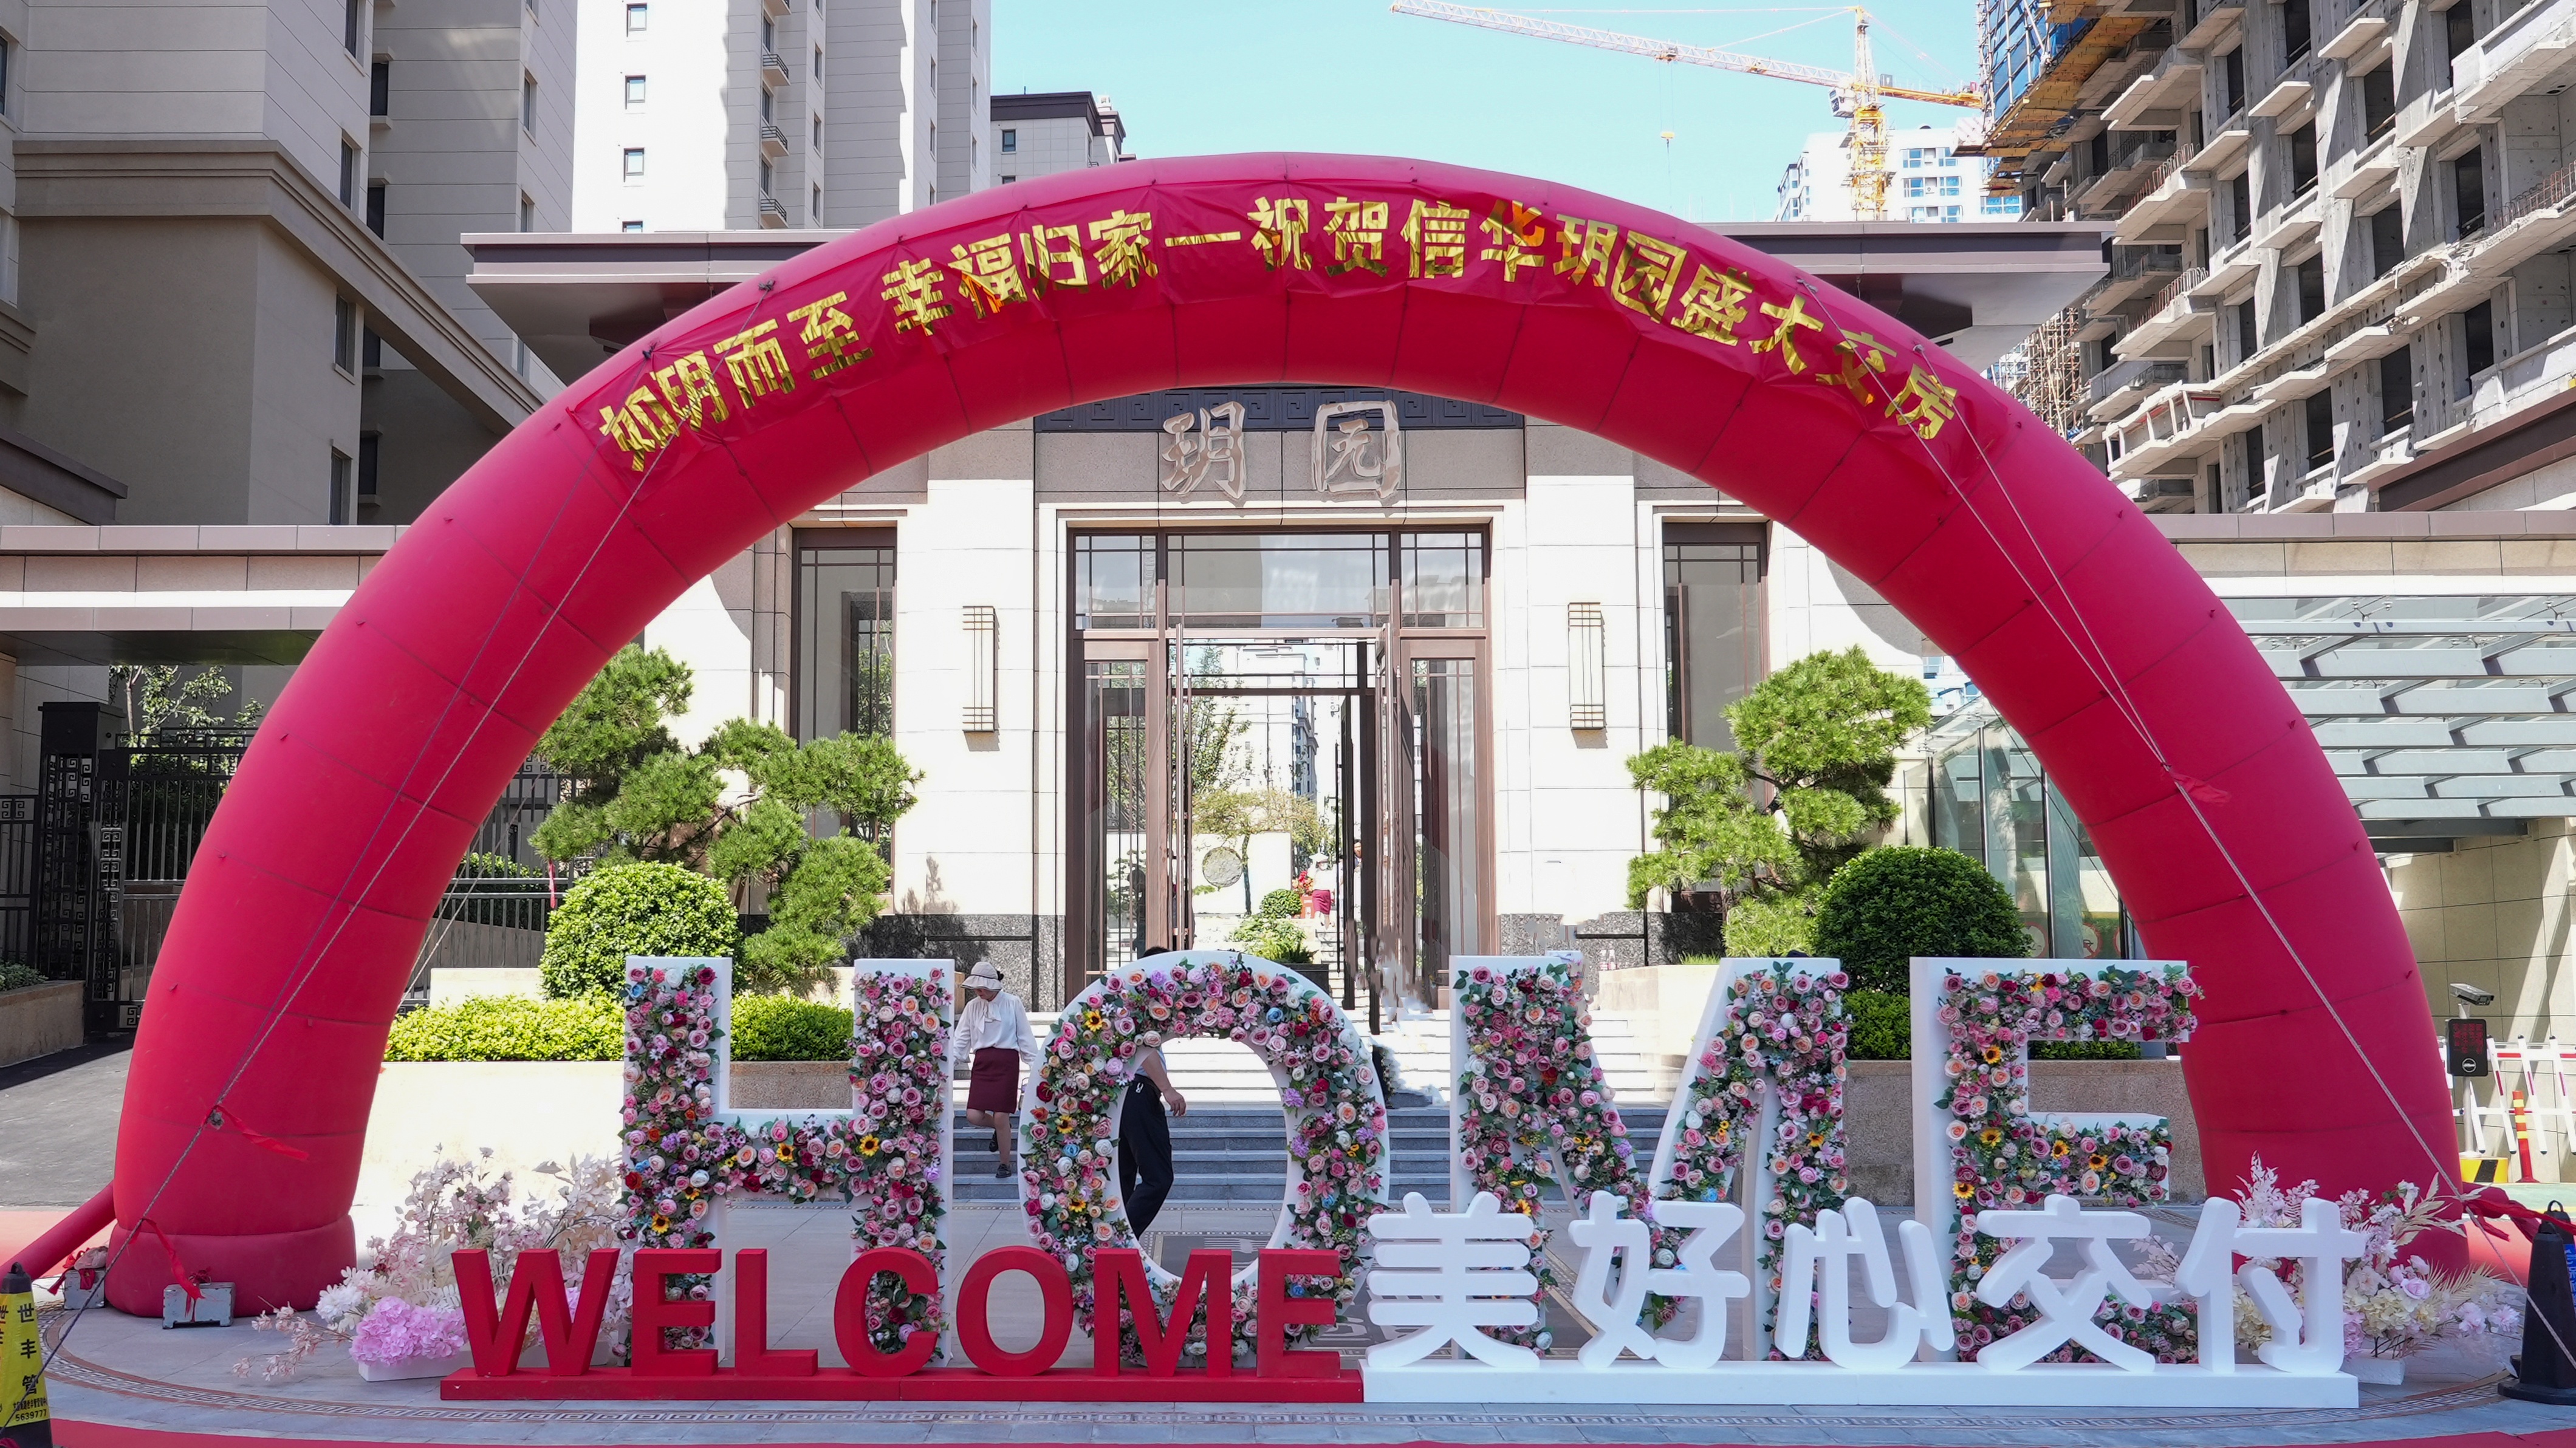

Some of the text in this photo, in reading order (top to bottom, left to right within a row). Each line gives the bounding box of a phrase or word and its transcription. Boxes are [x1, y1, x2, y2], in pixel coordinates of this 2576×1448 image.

[599, 290, 873, 471] 如玥而至
[1161, 398, 1404, 504] 玥园
[623, 949, 2194, 1367] HOME
[451, 1245, 1341, 1378] WELCOME
[1366, 1190, 2365, 1373] 美好心交付
[15, 1409, 47, 1422] 5639777
